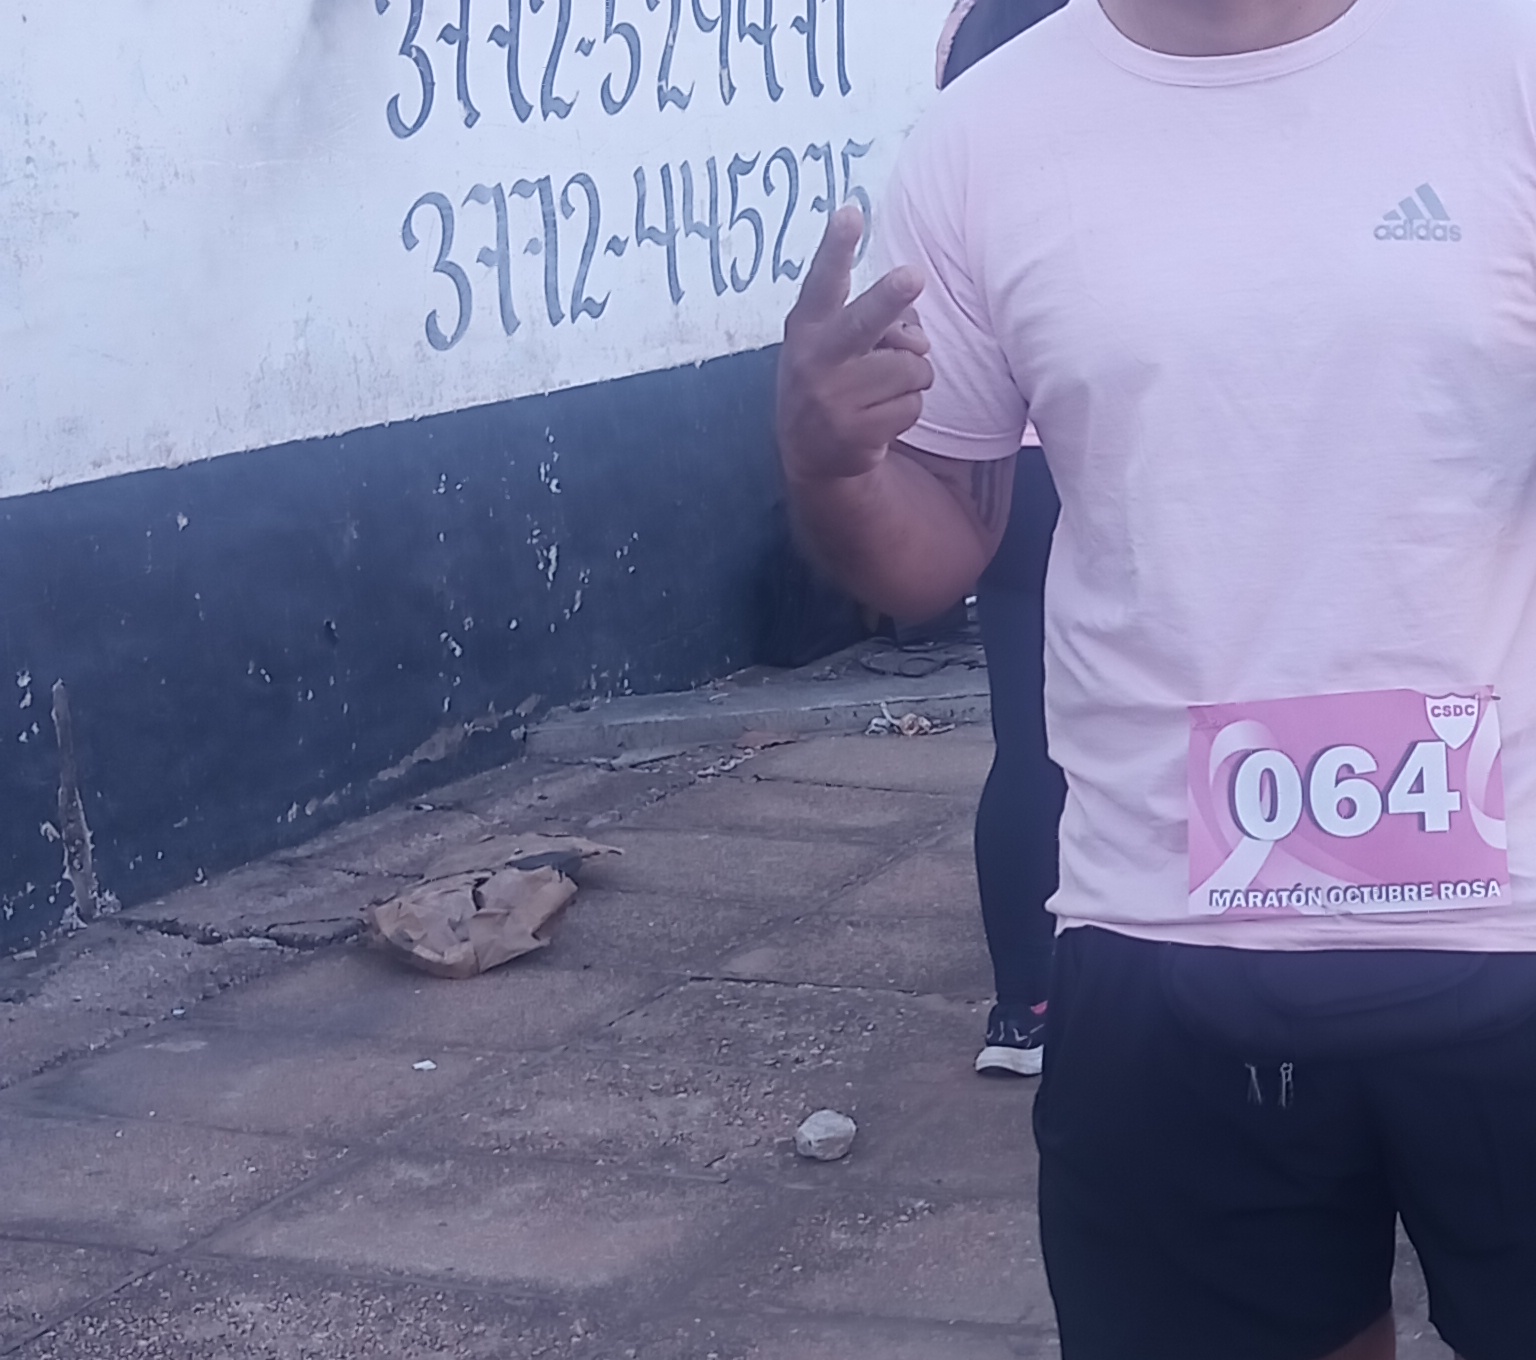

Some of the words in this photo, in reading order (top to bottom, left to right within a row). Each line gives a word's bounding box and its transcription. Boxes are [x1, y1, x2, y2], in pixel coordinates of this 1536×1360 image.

[1373, 218, 1463, 242] adidas
[1429, 704, 1476, 718] CSDC
[1227, 739, 1462, 842] 064
[1208, 883, 1323, 909] MARATÓN
[1326, 880, 1434, 906] OCTUBRE
[1438, 879, 1502, 900] ROSA
